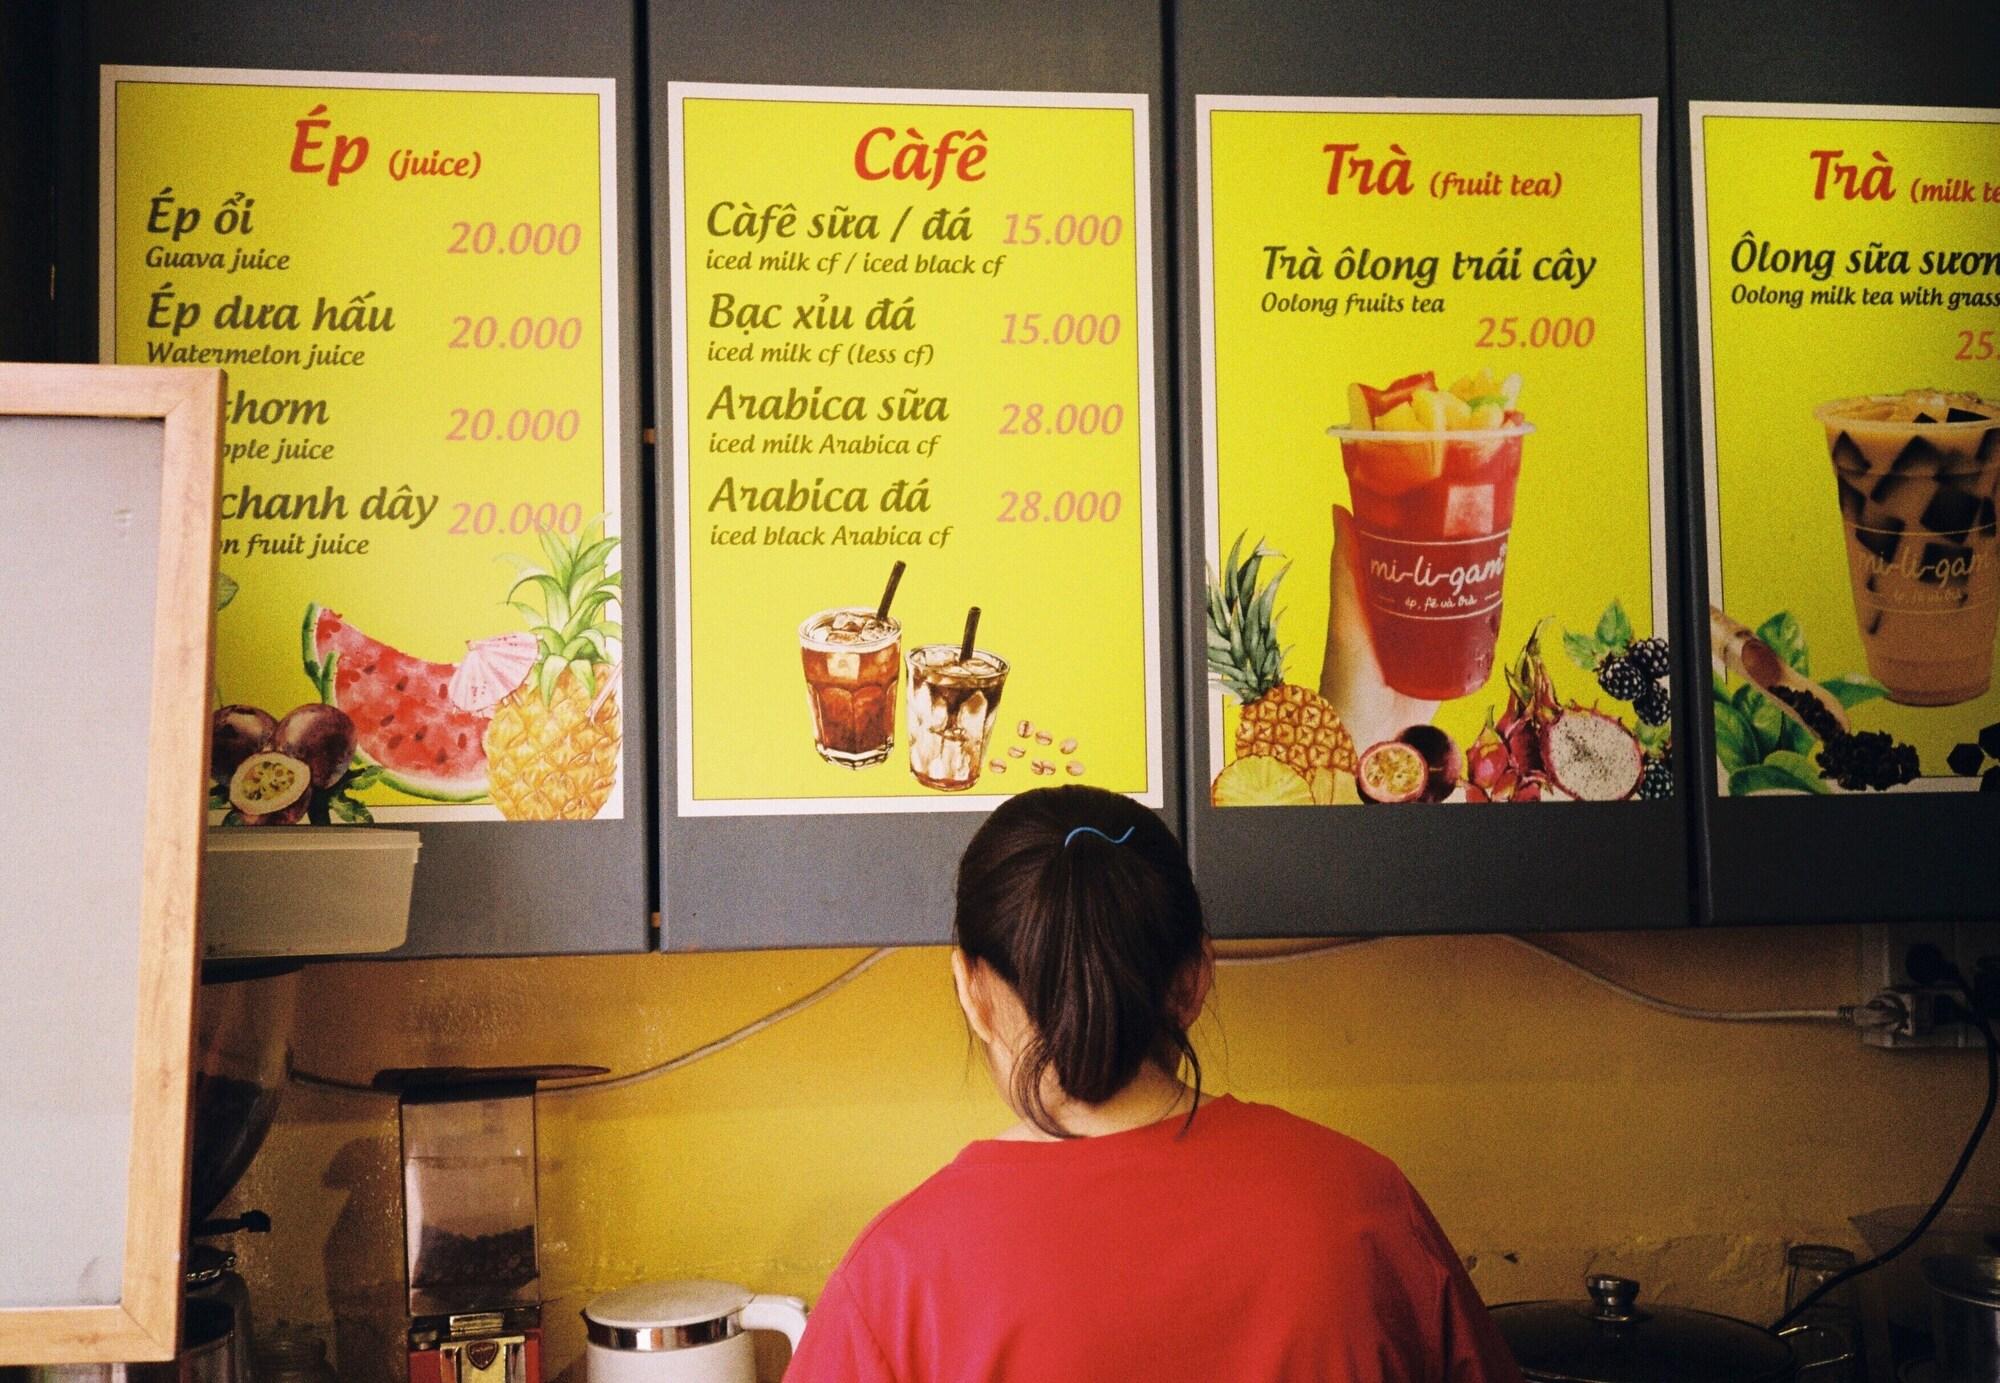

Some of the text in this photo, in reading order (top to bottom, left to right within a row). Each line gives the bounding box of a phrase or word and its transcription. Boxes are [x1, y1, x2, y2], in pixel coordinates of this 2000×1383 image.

[290, 104, 481, 187] Ép (juice)
[854, 127, 987, 190] Càfê
[1323, 144, 1562, 199] Trà (fruit tea)
[1810, 150, 1896, 201] Trà
[1911, 178, 1976, 203] (milk
[147, 187, 254, 242] Ép ổi
[707, 201, 972, 243] Càfê sữa / đá
[1003, 213, 1123, 246] 15.000
[447, 221, 582, 256] 20.000
[1731, 230, 1836, 281] Ôlong
[1846, 242, 1910, 274] sữa
[145, 245, 290, 274] Guava juice
[706, 249, 1007, 277] iced milk cf / iced black cf
[1263, 246, 1597, 289] Trà ôlong trái cây
[147, 282, 394, 337] Ép dưa hấu
[709, 293, 915, 335] Bạc xỉu đá
[1261, 292, 1445, 317] Oolong fruits tea
[1731, 284, 1804, 309] Oolong
[1811, 285, 1856, 305] milk
[1862, 288, 1894, 305] tea
[1900, 287, 1943, 306] with
[448, 315, 582, 350] 20.000
[1001, 313, 1121, 346] 15.000
[1475, 317, 1595, 348] 25.000
[145, 340, 365, 370] Watermelon juice
[708, 341, 934, 367] iced milk cf (less cf)
[228, 390, 328, 425] hơm
[707, 385, 949, 421] Arabica sữa
[999, 403, 1124, 436] 28.000
[445, 407, 580, 442] 20.000
[271, 438, 334, 464] juice
[709, 433, 941, 457] iced milk Arabica cf
[223, 484, 438, 529] chanh dây
[708, 477, 930, 512] Arabica đá
[997, 490, 1122, 523] 28.000
[448, 502, 582, 537] 20.000
[711, 525, 953, 548] iced black Arabica cf
[245, 533, 304, 558] fruit
[307, 533, 369, 560] juice
